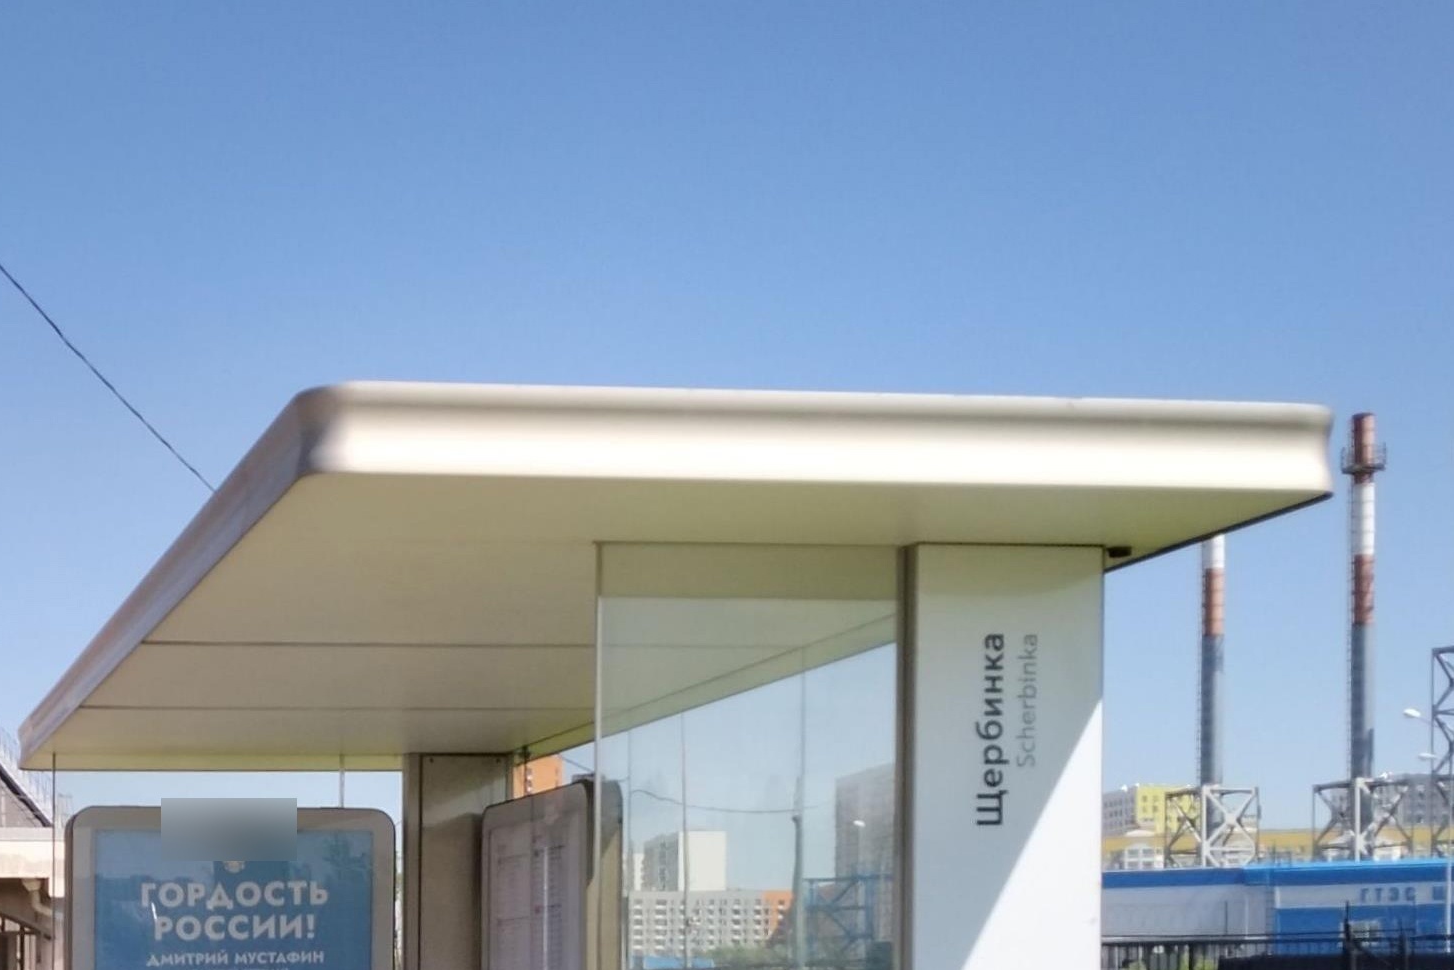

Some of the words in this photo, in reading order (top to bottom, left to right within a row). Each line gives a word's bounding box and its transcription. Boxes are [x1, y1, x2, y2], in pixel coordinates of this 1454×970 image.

[1016, 634, 1038, 767] Scherbinka
[974, 633, 1009, 826] Щербинка
[140, 880, 329, 910] ГОРДОСТЬ
[153, 914, 316, 941] РОССИИ!
[146, 949, 228, 967] ДМИТРИЙ
[235, 951, 325, 965] МУСТАФИН
